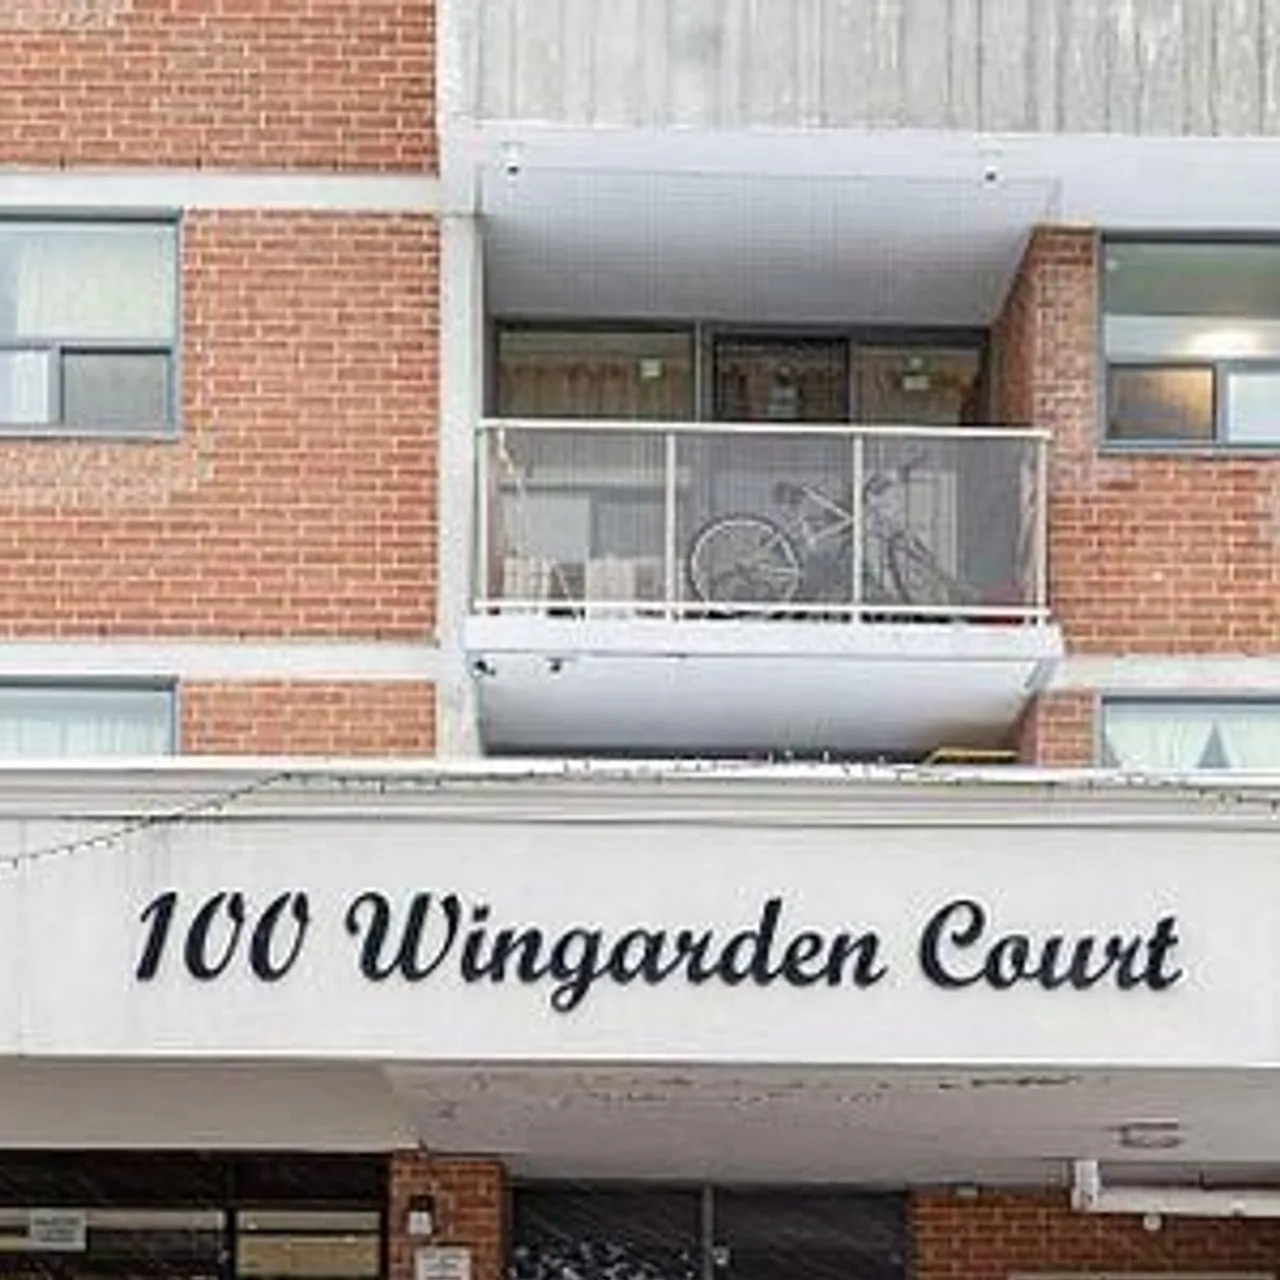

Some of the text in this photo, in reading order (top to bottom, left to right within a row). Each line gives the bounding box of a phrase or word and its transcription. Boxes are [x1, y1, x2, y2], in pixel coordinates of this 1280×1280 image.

[134, 891, 1183, 1014] 100 Wingarden Court
